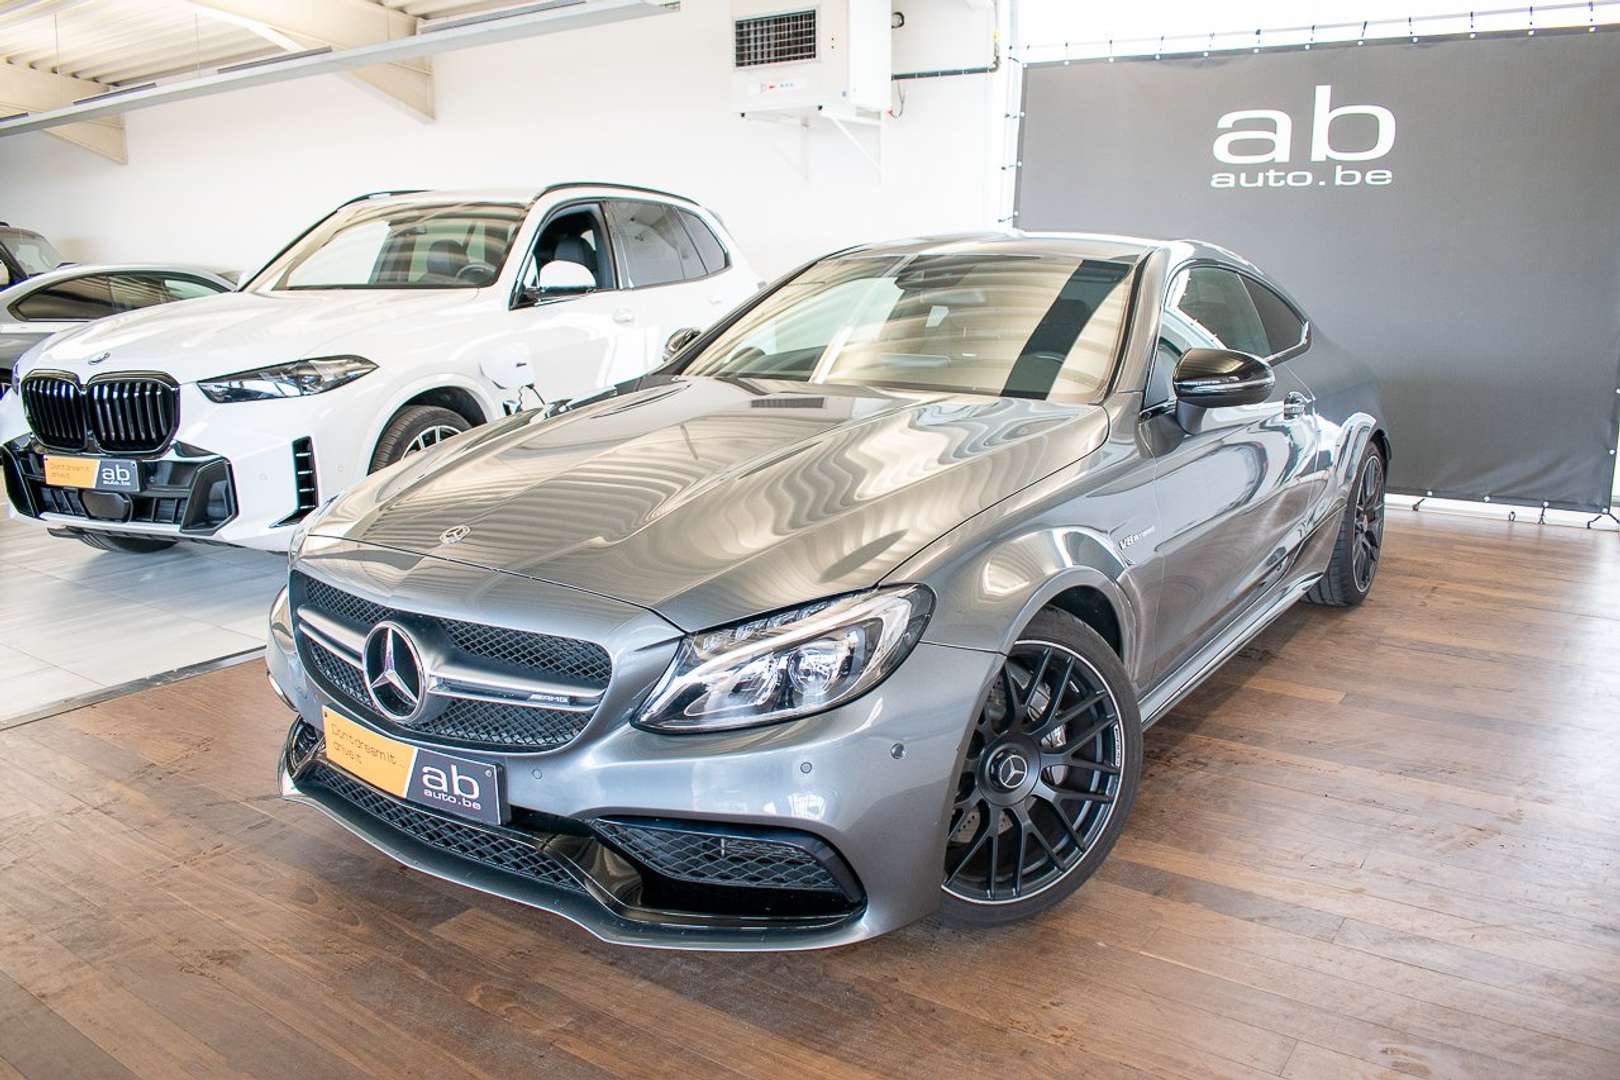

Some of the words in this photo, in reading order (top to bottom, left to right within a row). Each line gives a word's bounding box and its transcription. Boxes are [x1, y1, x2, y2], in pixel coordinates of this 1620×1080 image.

[1213, 85, 1396, 164] ab
[1210, 165, 1393, 188] auto.be
[102, 464, 130, 480] ab
[422, 764, 480, 799] ab
[423, 789, 482, 810] auto.be
